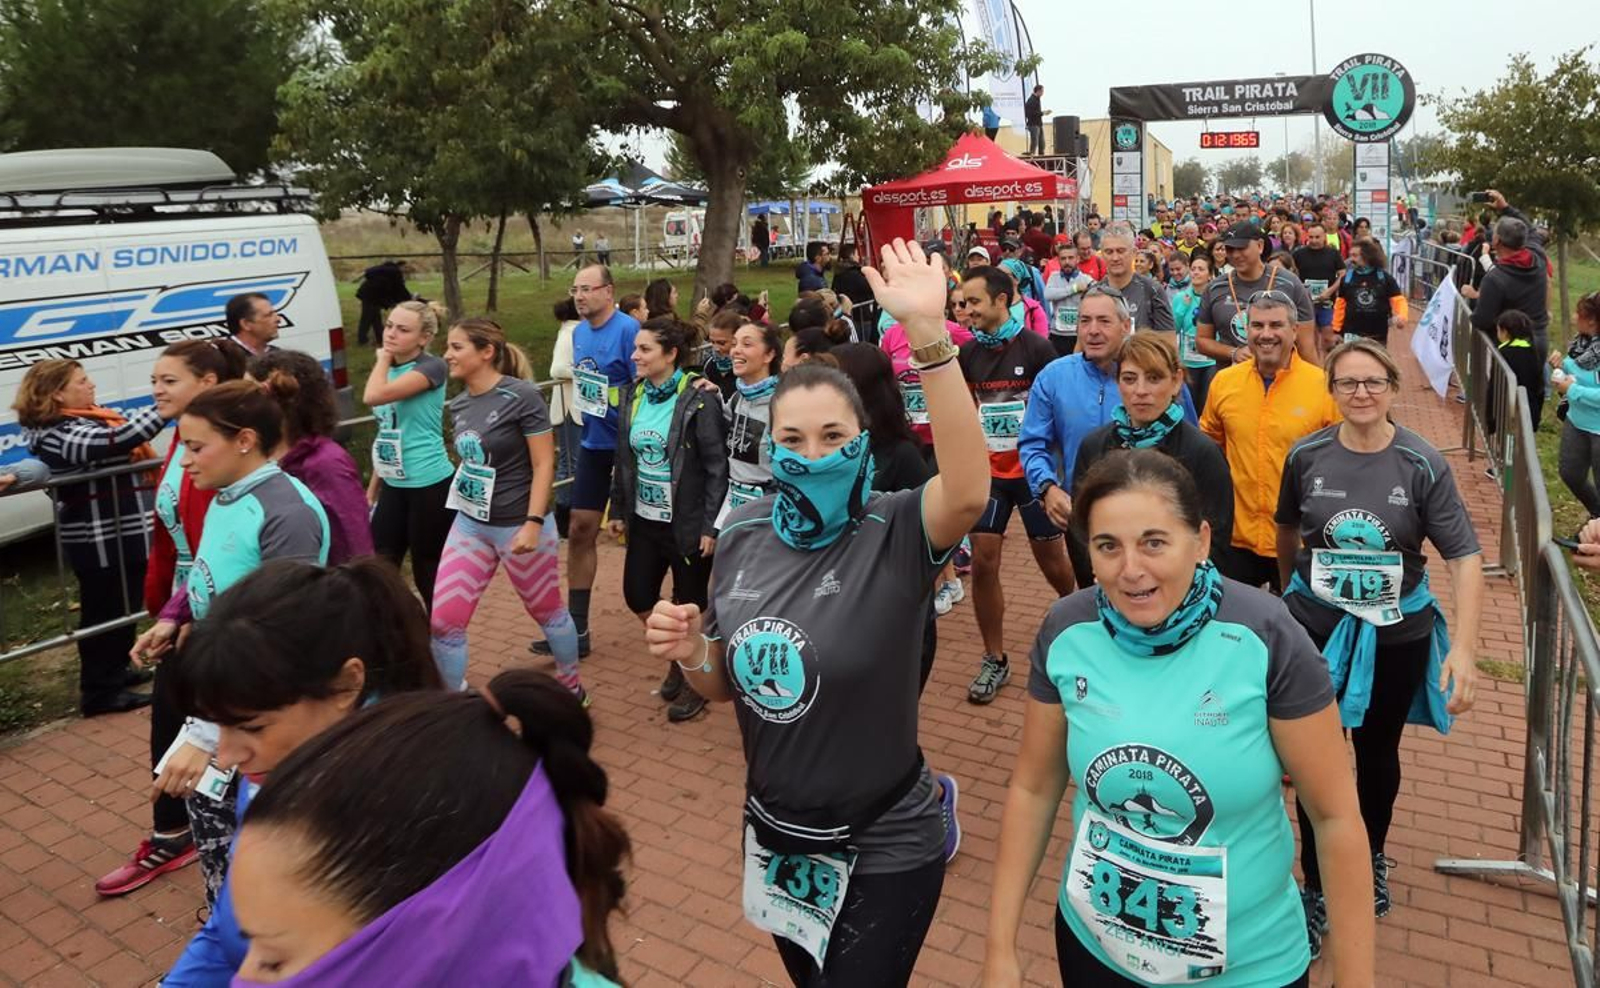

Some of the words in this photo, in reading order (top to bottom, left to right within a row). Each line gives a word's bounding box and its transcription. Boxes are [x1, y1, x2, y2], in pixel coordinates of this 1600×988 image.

[1329, 58, 1361, 80] TRAIL
[1365, 55, 1406, 79] PIRATA
[1182, 85, 1229, 102] TRAIL
[1235, 82, 1298, 99] PIRATA
[1346, 72, 1389, 101] VII
[1187, 104, 1218, 115] Sierra
[1222, 103, 1242, 113] San
[873, 188, 947, 205] alssport.es
[964, 181, 1043, 199] alssport.es
[113, 238, 297, 268] SONIDO.COM
[1326, 511, 1363, 536] CAMINATA
[1366, 514, 1392, 543] PIRATA
[1331, 570, 1383, 600] 719
[731, 622, 760, 649] TRAIL
[764, 621, 806, 652] PIRATA
[744, 641, 790, 676] VII
[1087, 748, 1150, 789] CAMINATA
[1155, 754, 1207, 807] PIRATA
[1128, 768, 1154, 781] 2018
[1120, 838, 1157, 860] CAMINATA
[1157, 854, 1191, 866] PIRATA
[765, 853, 838, 910] 739
[1089, 860, 1199, 940] 843
[1104, 922, 1135, 944] ZEB
